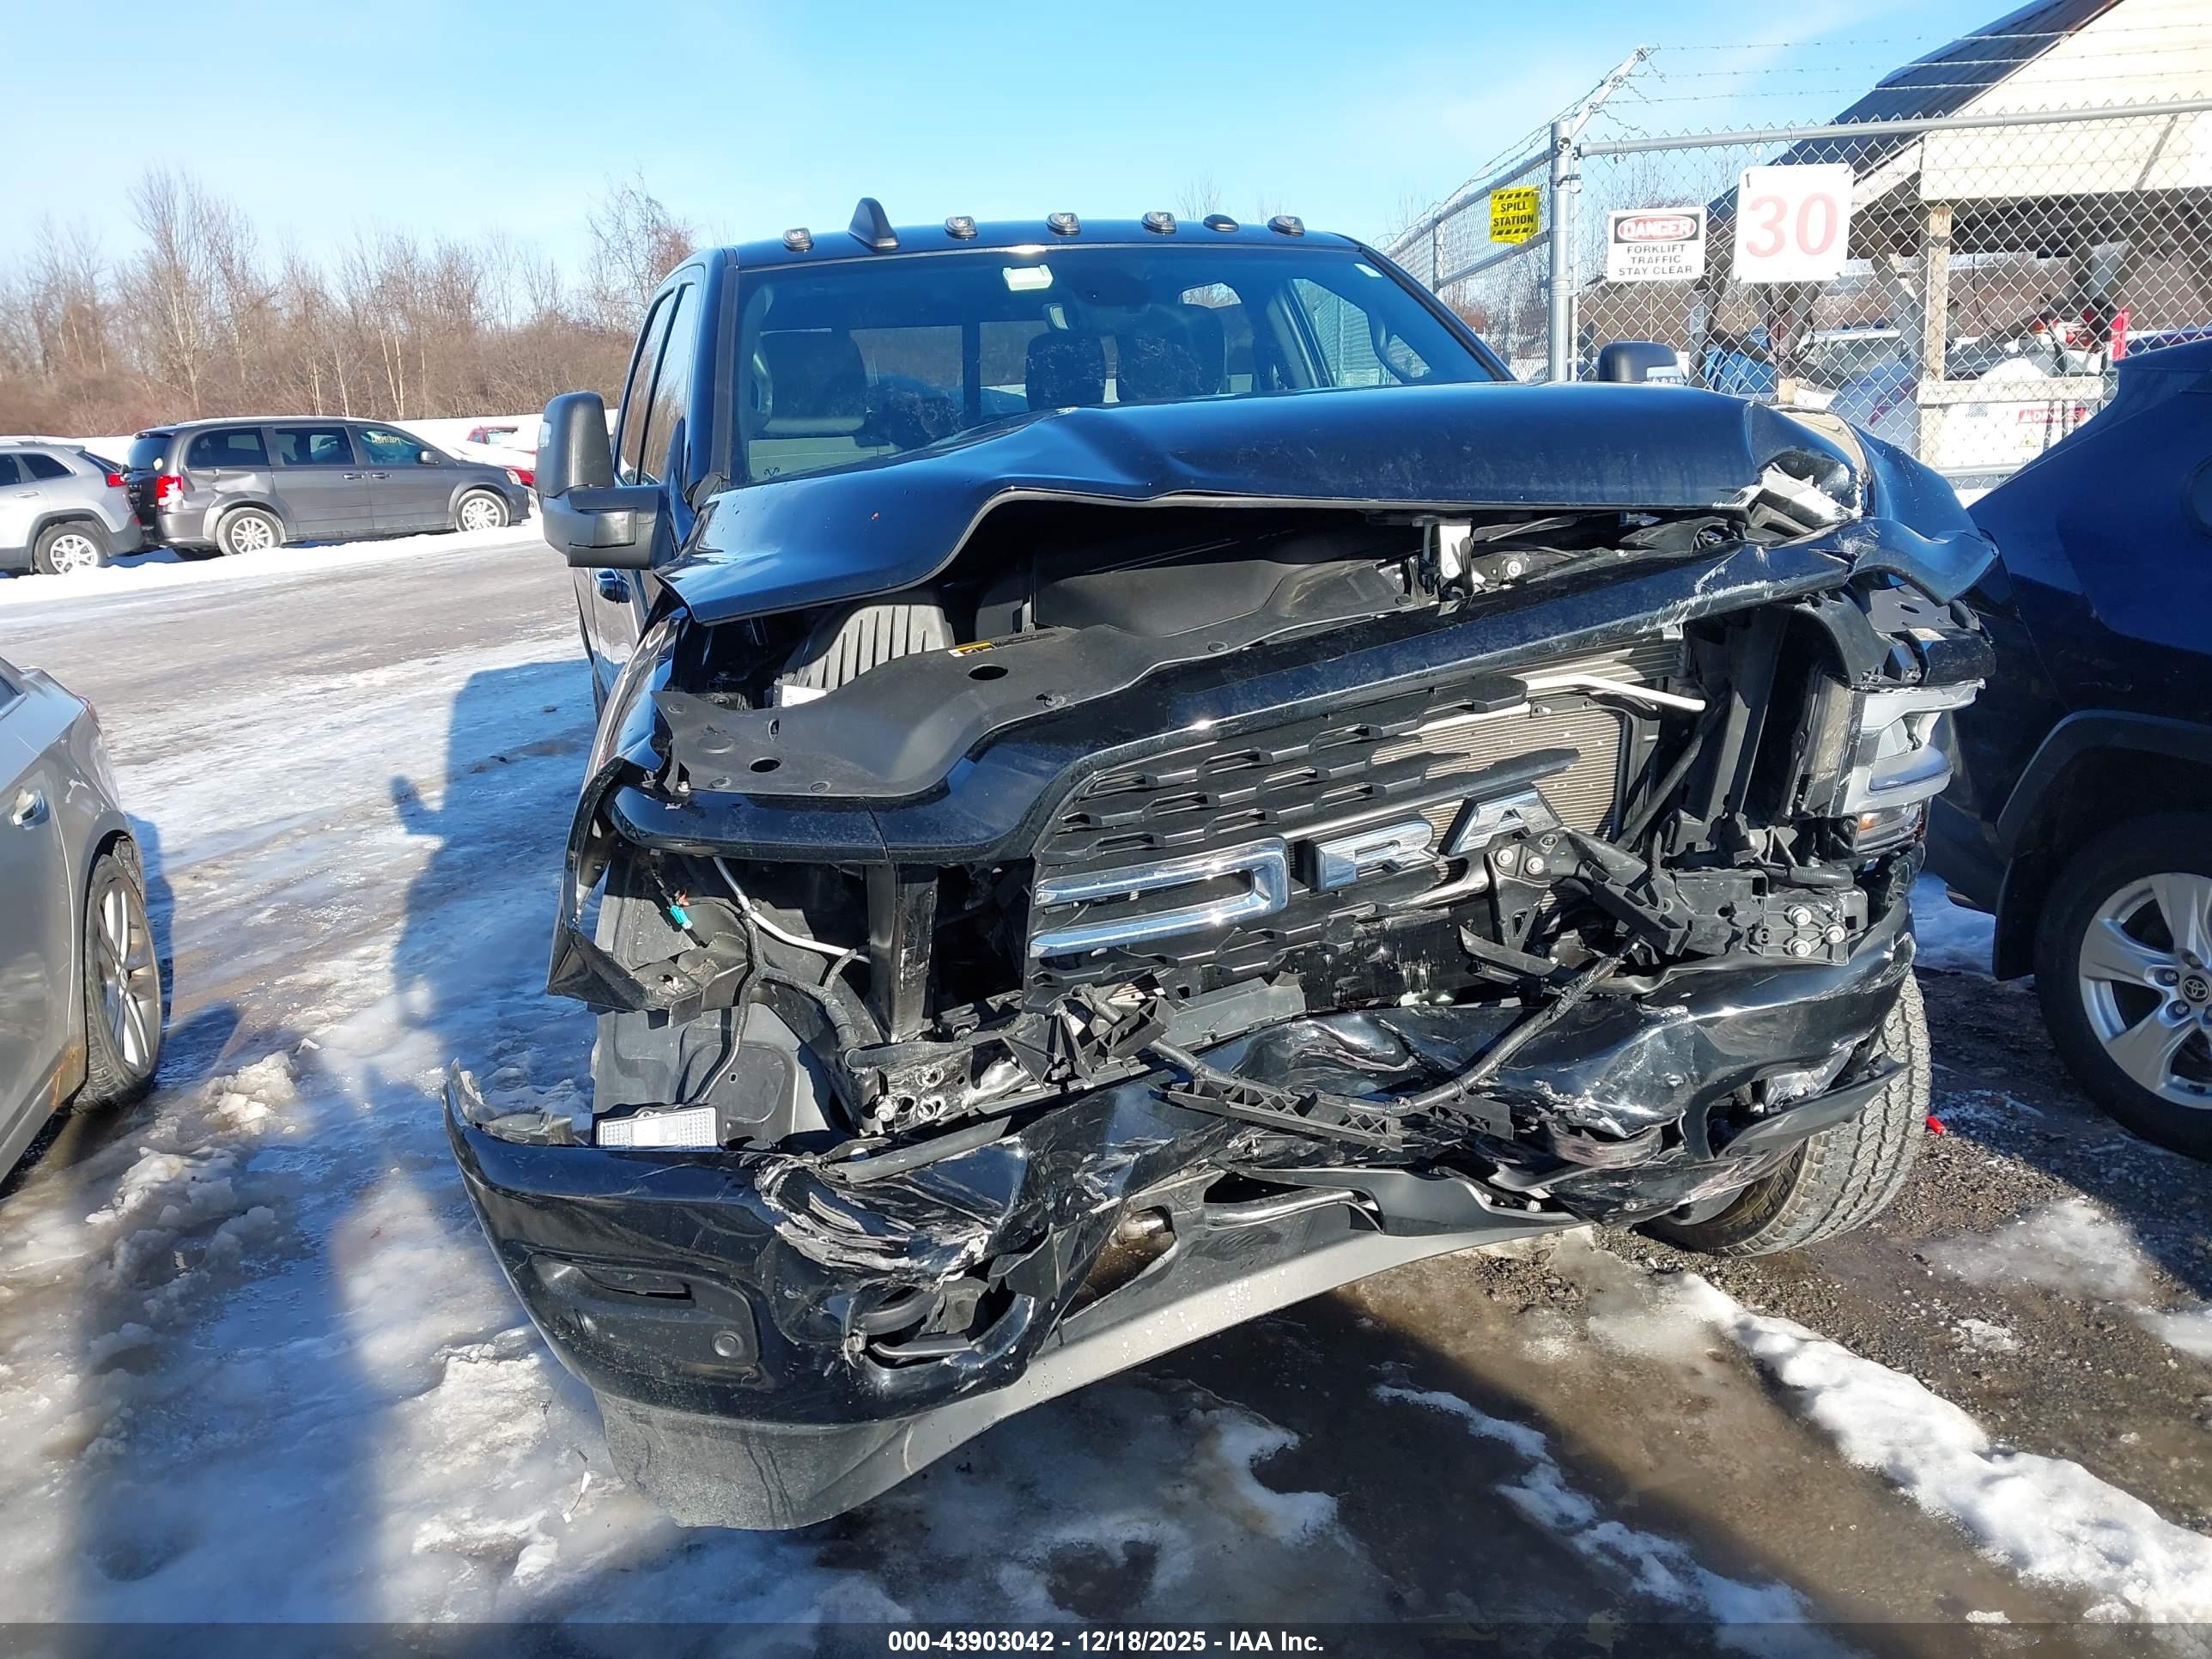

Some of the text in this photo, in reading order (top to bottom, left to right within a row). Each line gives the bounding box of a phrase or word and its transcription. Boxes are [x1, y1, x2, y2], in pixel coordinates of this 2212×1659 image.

[1500, 200, 1528, 212] SPILL
[1492, 213, 1534, 227] STATION
[1746, 191, 1839, 258] 30
[1623, 219, 1692, 238] DANGER
[1626, 244, 1686, 254] FORKLIFT
[1630, 255, 1681, 265] TRAFFIC
[1618, 264, 1693, 276] STAY CLEAR
